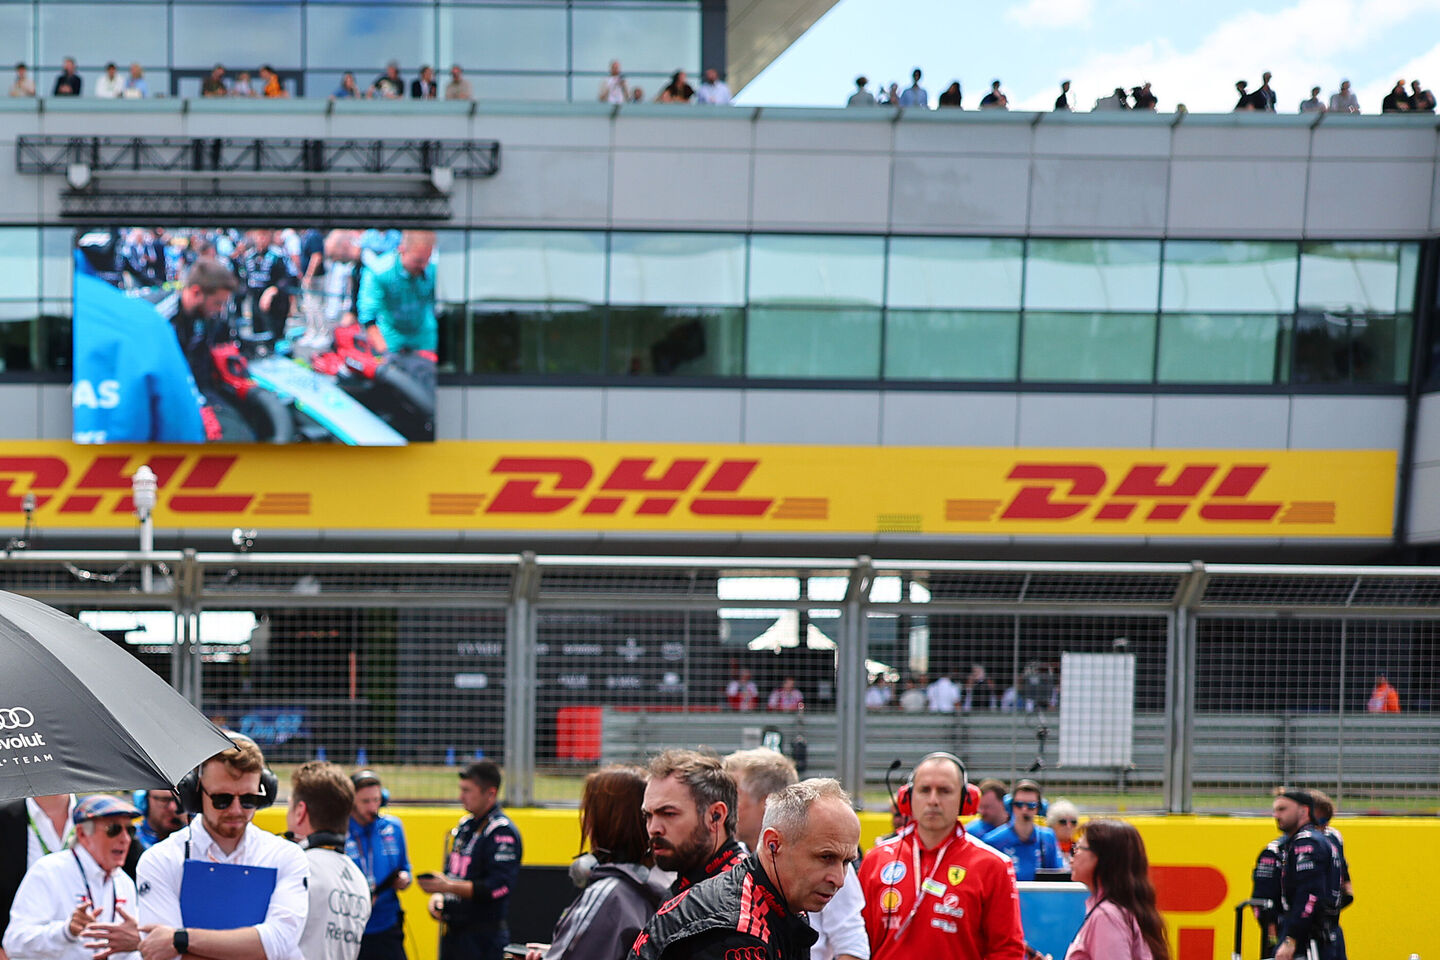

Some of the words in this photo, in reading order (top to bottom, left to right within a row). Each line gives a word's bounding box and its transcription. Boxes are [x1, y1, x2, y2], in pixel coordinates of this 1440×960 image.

[486, 457, 774, 517] DHL
[1000, 463, 1282, 522] DHL
[13, 753, 53, 765] TEAM
